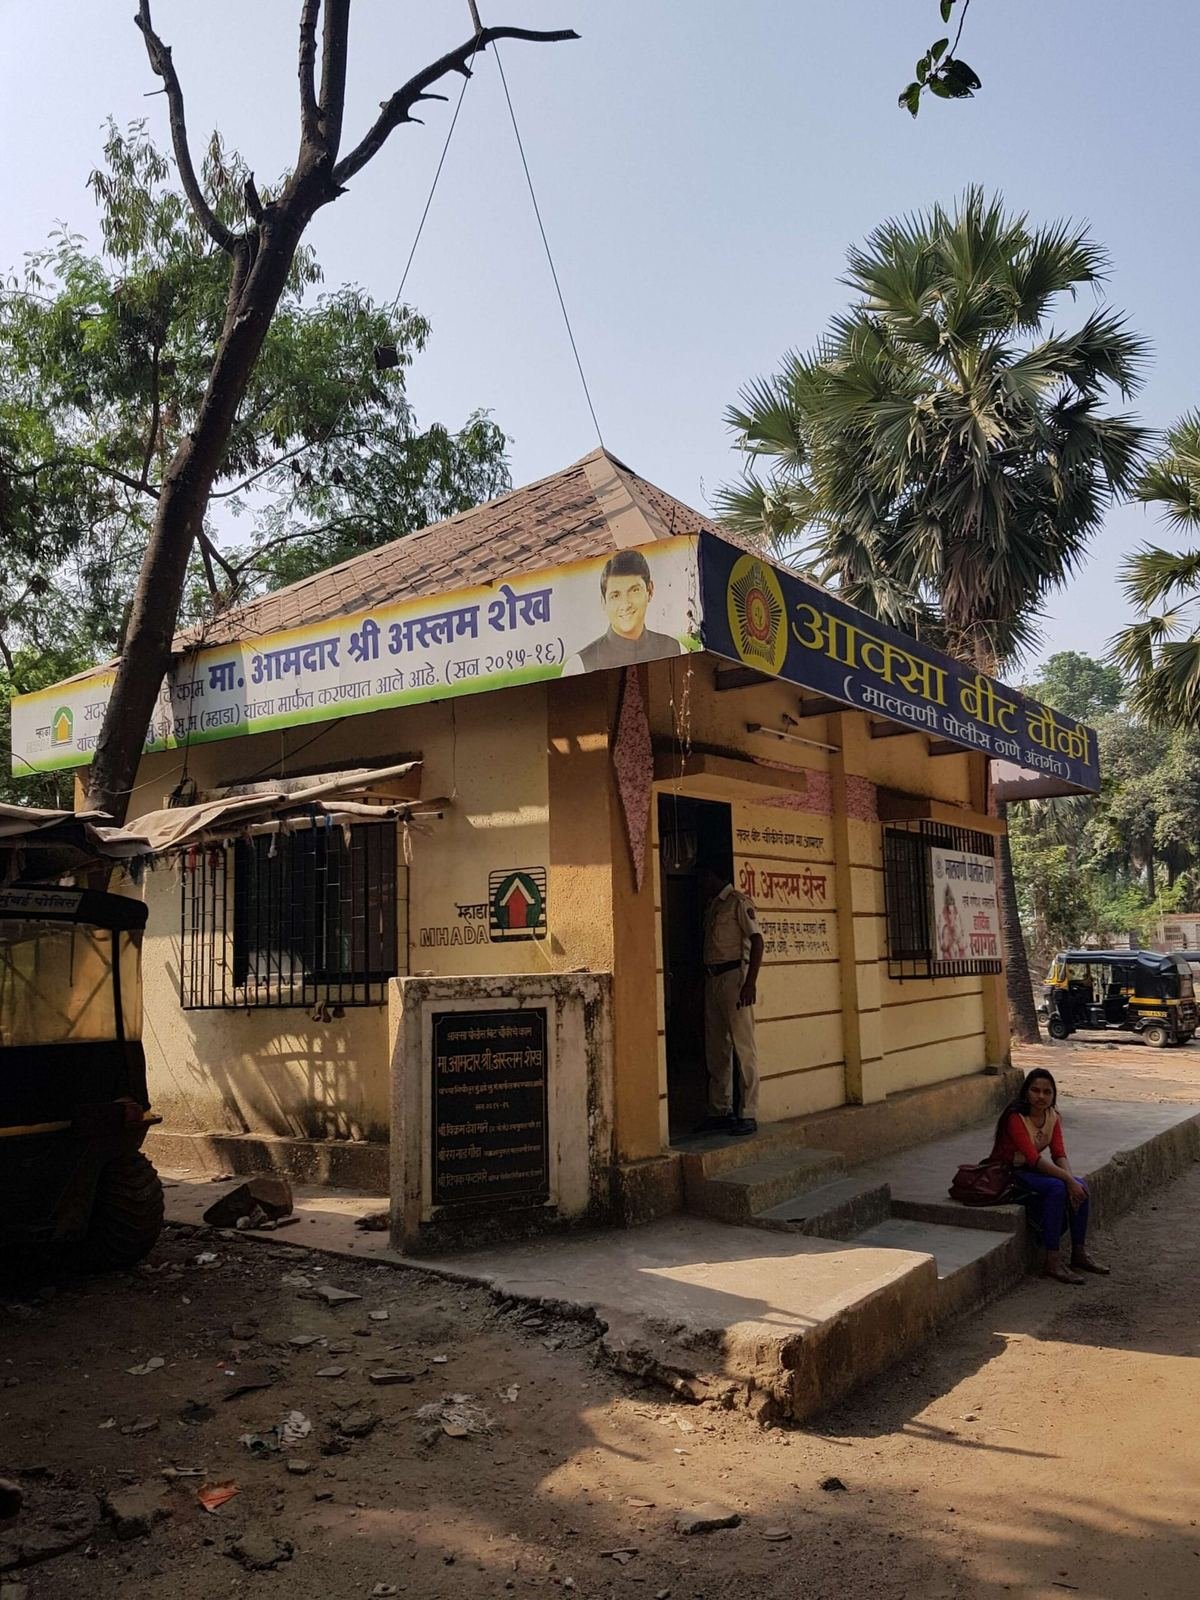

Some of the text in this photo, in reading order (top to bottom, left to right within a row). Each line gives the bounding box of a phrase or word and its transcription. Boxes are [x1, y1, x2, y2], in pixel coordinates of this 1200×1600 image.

[208, 661, 244, 692] मा.
[251, 637, 340, 684] आमदार
[348, 619, 381, 663] श्री
[388, 605, 480, 655] अस्लम
[488, 584, 553, 632] शेख
[244, 698, 274, 719] यांच्या
[278, 687, 313, 713] मार्फत
[318, 680, 371, 706] करण्यात
[376, 667, 404, 693] आले
[408, 661, 439, 689] आहे.
[445, 657, 480, 686] (सन
[792, 603, 1091, 766] आक्सा बीट चौकी
[943, 712, 992, 750] पोलीस
[994, 738, 1021, 761] ठाणे
[455, 903, 488, 925] म्हाडा
[420, 925, 489, 947] MHADA
[969, 933, 997, 956] स्वागत
[524, 1046, 543, 1067] शेख
